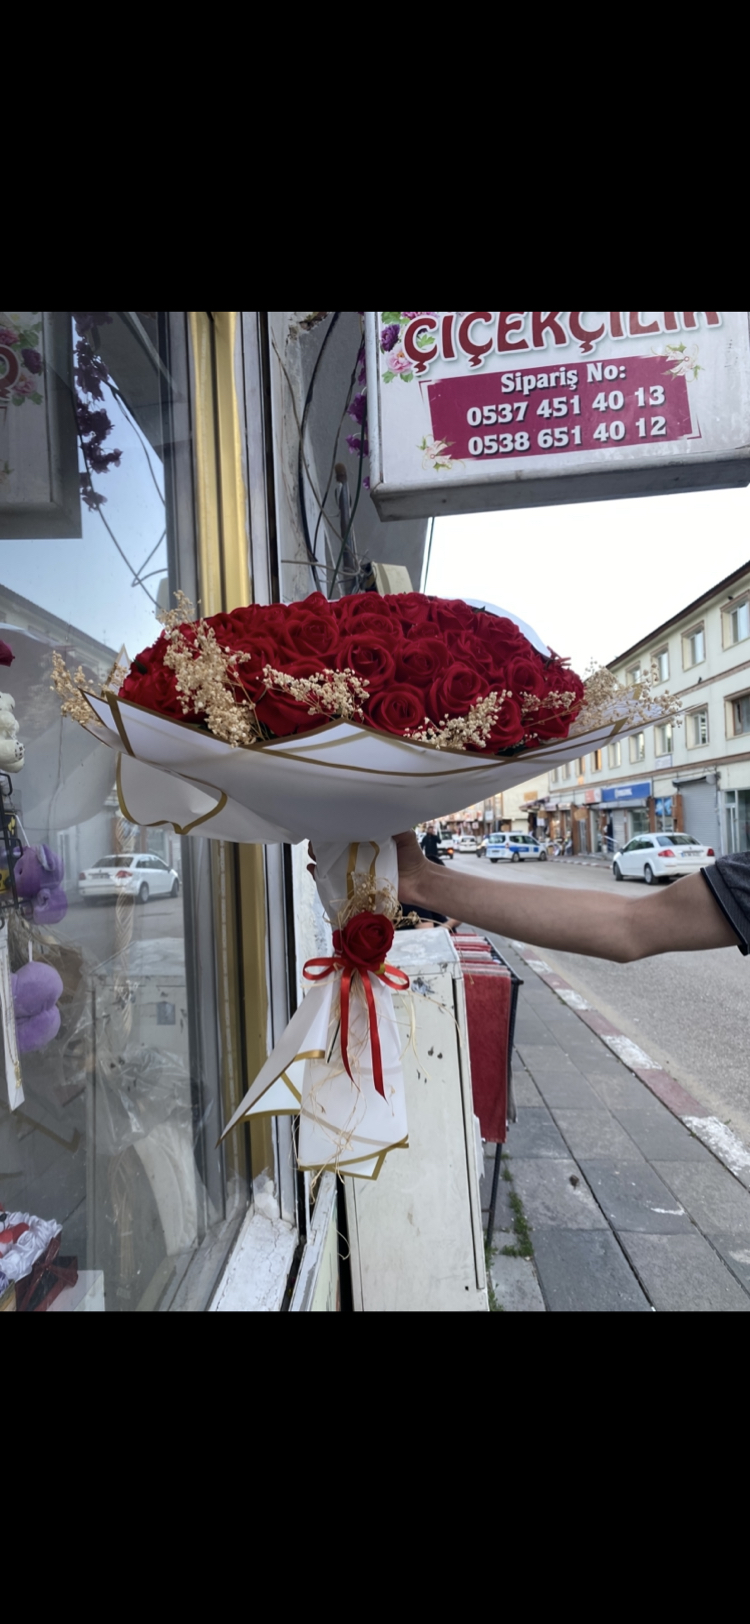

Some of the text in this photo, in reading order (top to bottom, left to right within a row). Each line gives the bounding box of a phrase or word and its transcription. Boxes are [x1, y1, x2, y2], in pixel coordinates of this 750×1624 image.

[500, 362, 626, 395] Sipariş No:
[466, 385, 665, 426] 0537 451 40 13
[468, 416, 666, 456] 0538 651 40 12
